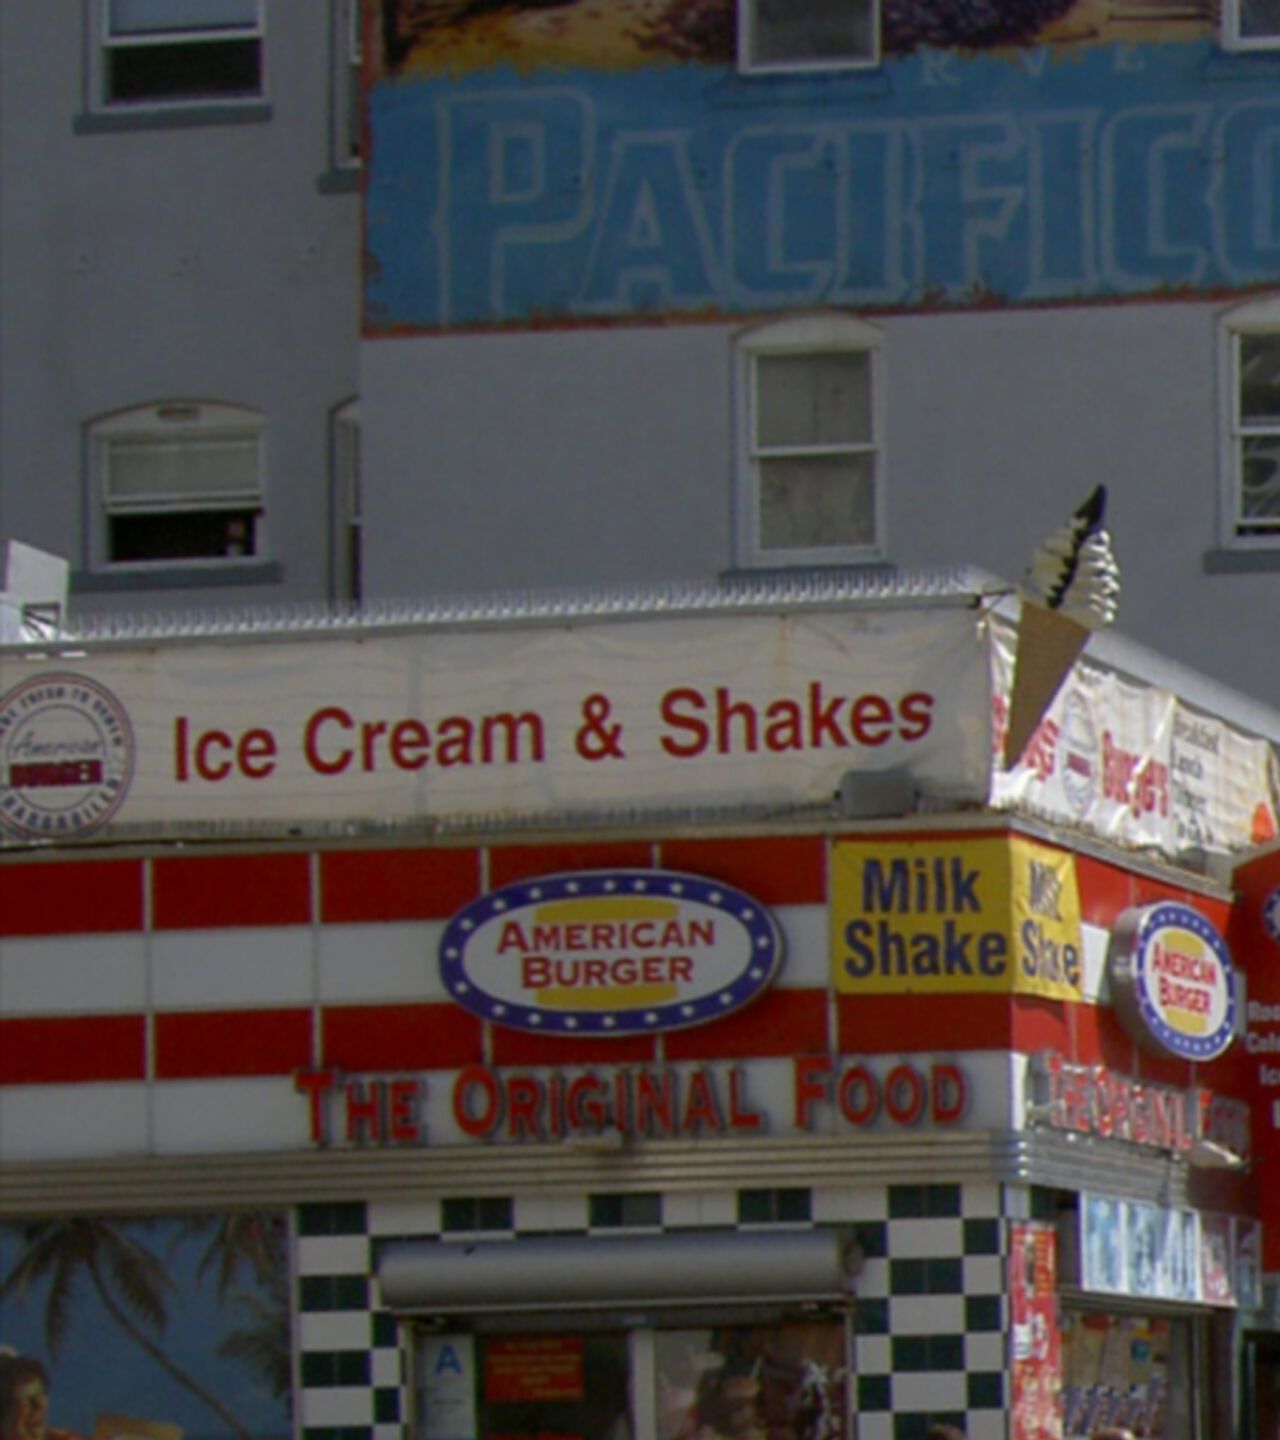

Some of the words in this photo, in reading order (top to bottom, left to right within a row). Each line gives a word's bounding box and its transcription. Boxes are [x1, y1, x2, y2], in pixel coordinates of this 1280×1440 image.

[173, 717, 277, 781] Ice
[303, 705, 545, 772] Cream
[574, 694, 624, 762] &
[659, 682, 936, 757] Shakes
[862, 857, 983, 914] Milk
[497, 920, 715, 954] AMERICAN
[844, 920, 1009, 980] Shake
[521, 957, 693, 988] BURGER
[1152, 943, 1217, 987] AMERICAN
[1158, 975, 1212, 1015] BURGER
[297, 1071, 421, 1144] THE
[452, 1065, 764, 1138] ORIGINAL
[792, 1055, 967, 1127] FOOD
[435, 1343, 462, 1375] A
